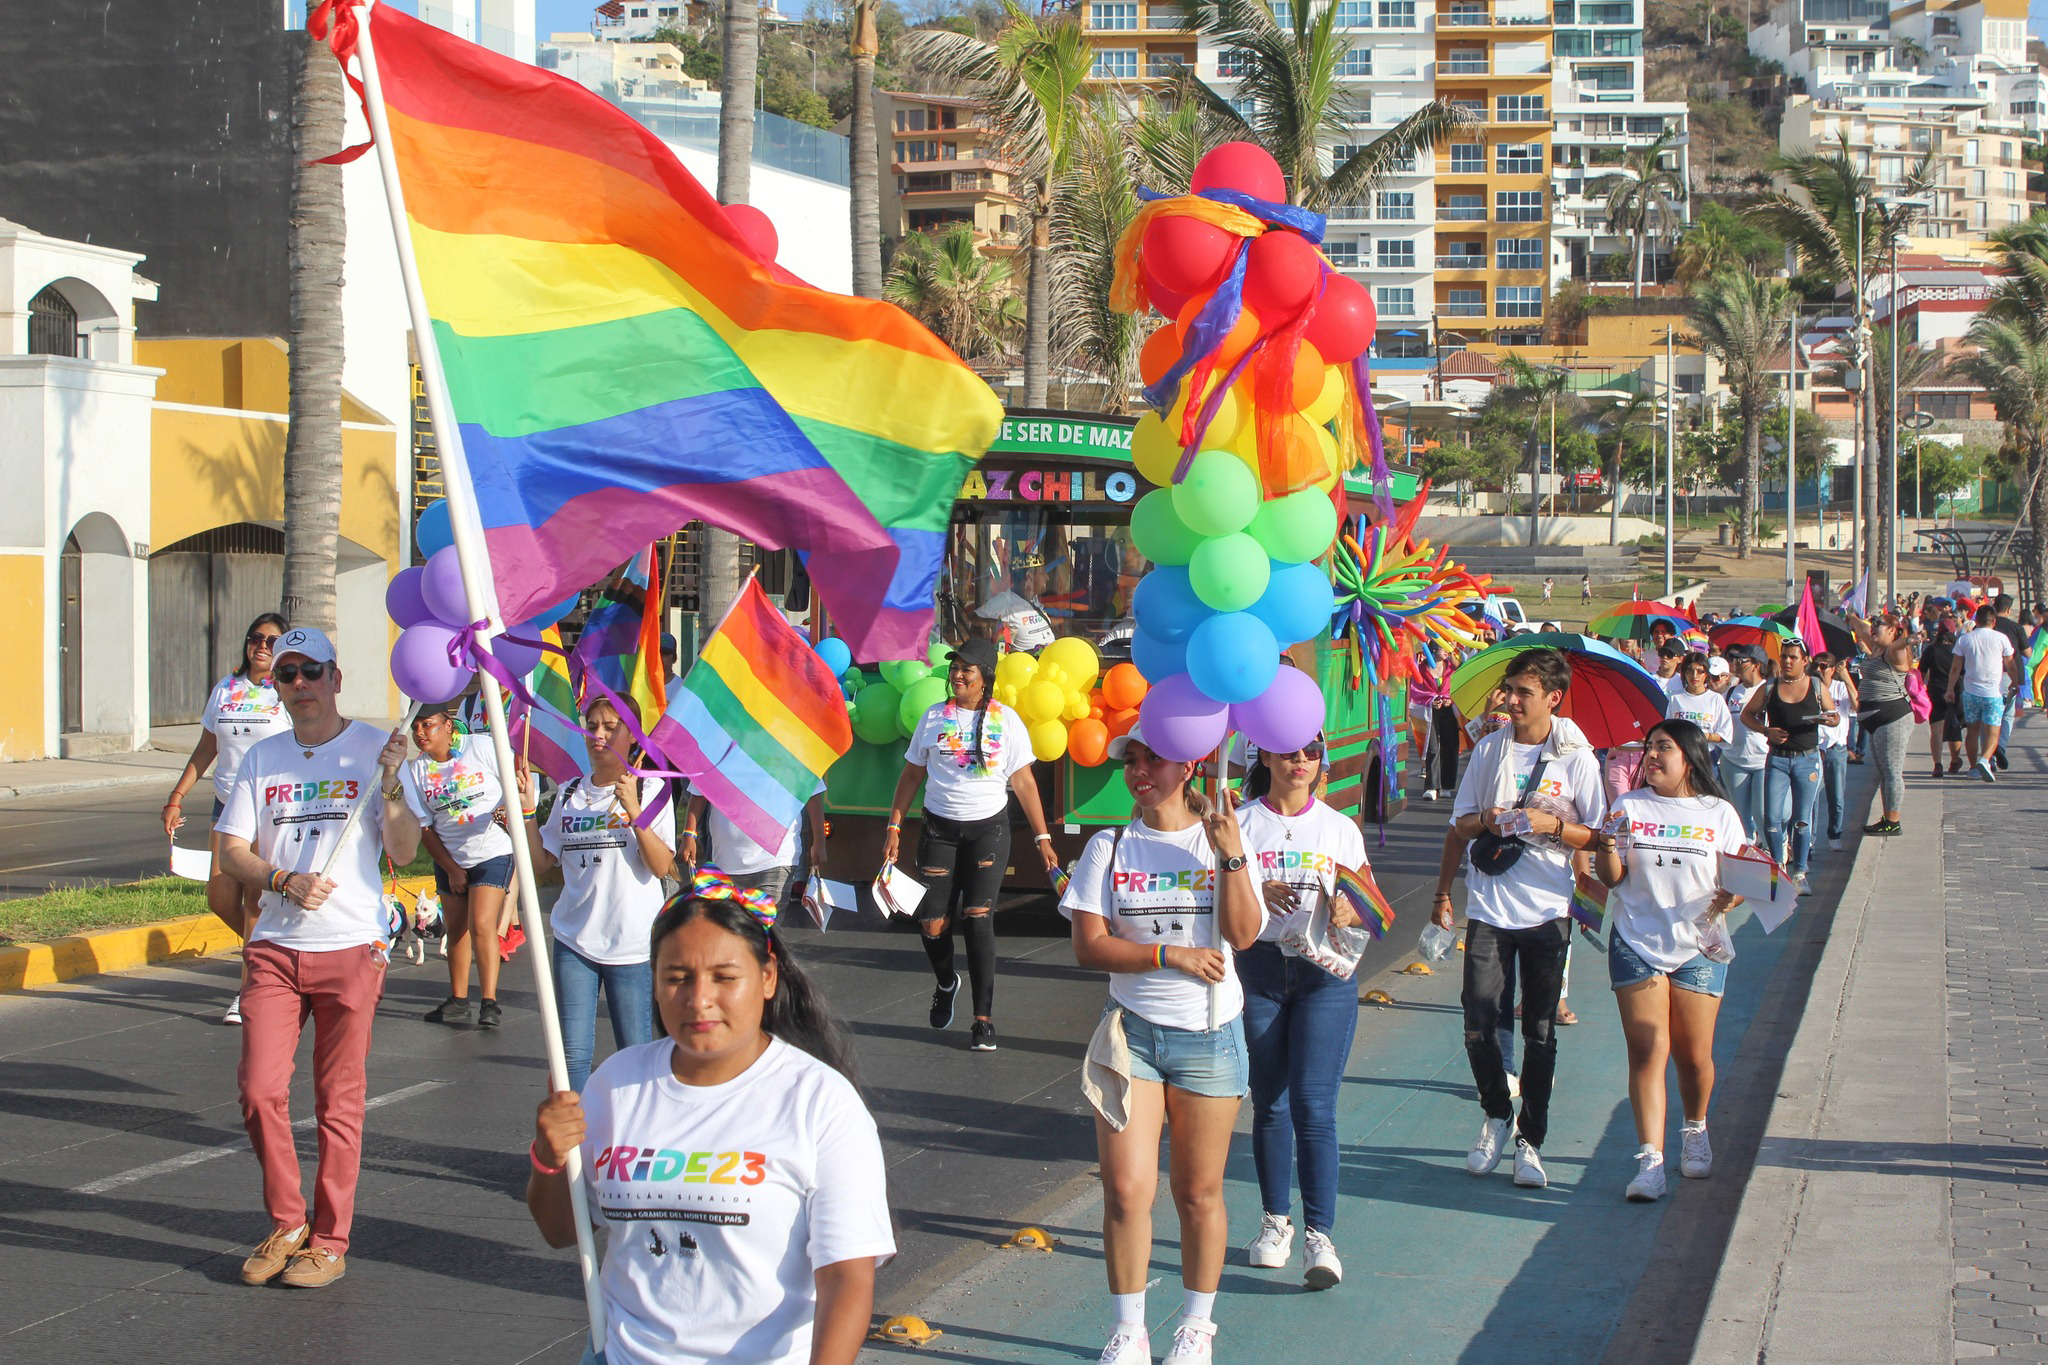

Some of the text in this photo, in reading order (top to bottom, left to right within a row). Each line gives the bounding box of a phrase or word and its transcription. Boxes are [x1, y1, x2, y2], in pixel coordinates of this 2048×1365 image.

[1017, 422, 1053, 442] SER
[1058, 424, 1084, 444] DE
[1018, 470, 1136, 503] CHILO
[677, 1193, 751, 1204] SINALOA
[638, 1211, 668, 1219] GRANDE
[684, 1212, 707, 1222] NORTE
[708, 1214, 724, 1223] DEL
[724, 1215, 745, 1224] PAÍS.
